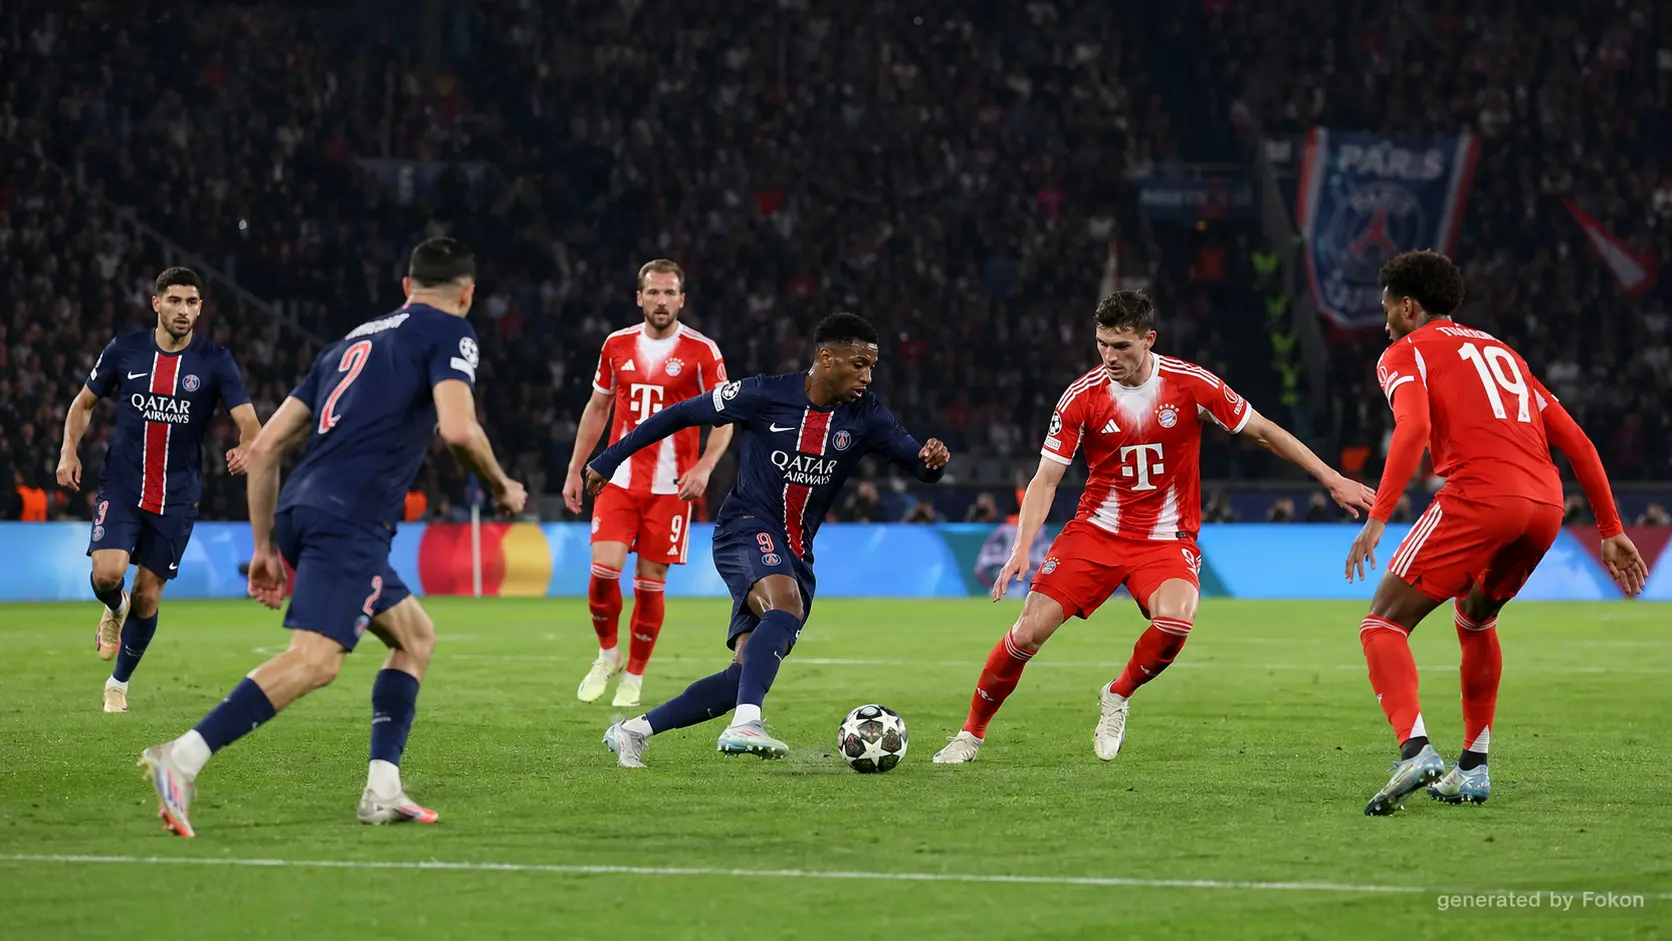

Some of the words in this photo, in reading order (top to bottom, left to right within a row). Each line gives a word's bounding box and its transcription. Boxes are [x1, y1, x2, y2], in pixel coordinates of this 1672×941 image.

[318, 340, 372, 434] 2
[1457, 342, 1531, 423] 19
[131, 393, 191, 414] QATAR
[142, 409, 189, 424] AIRWAYS
[770, 450, 837, 475] QATAR
[1120, 443, 1165, 491] T
[783, 470, 831, 486] AIRWAYS
[94, 500, 109, 526] 3
[669, 514, 683, 543] 9
[756, 532, 775, 553] 9
[362, 575, 383, 618] 2
